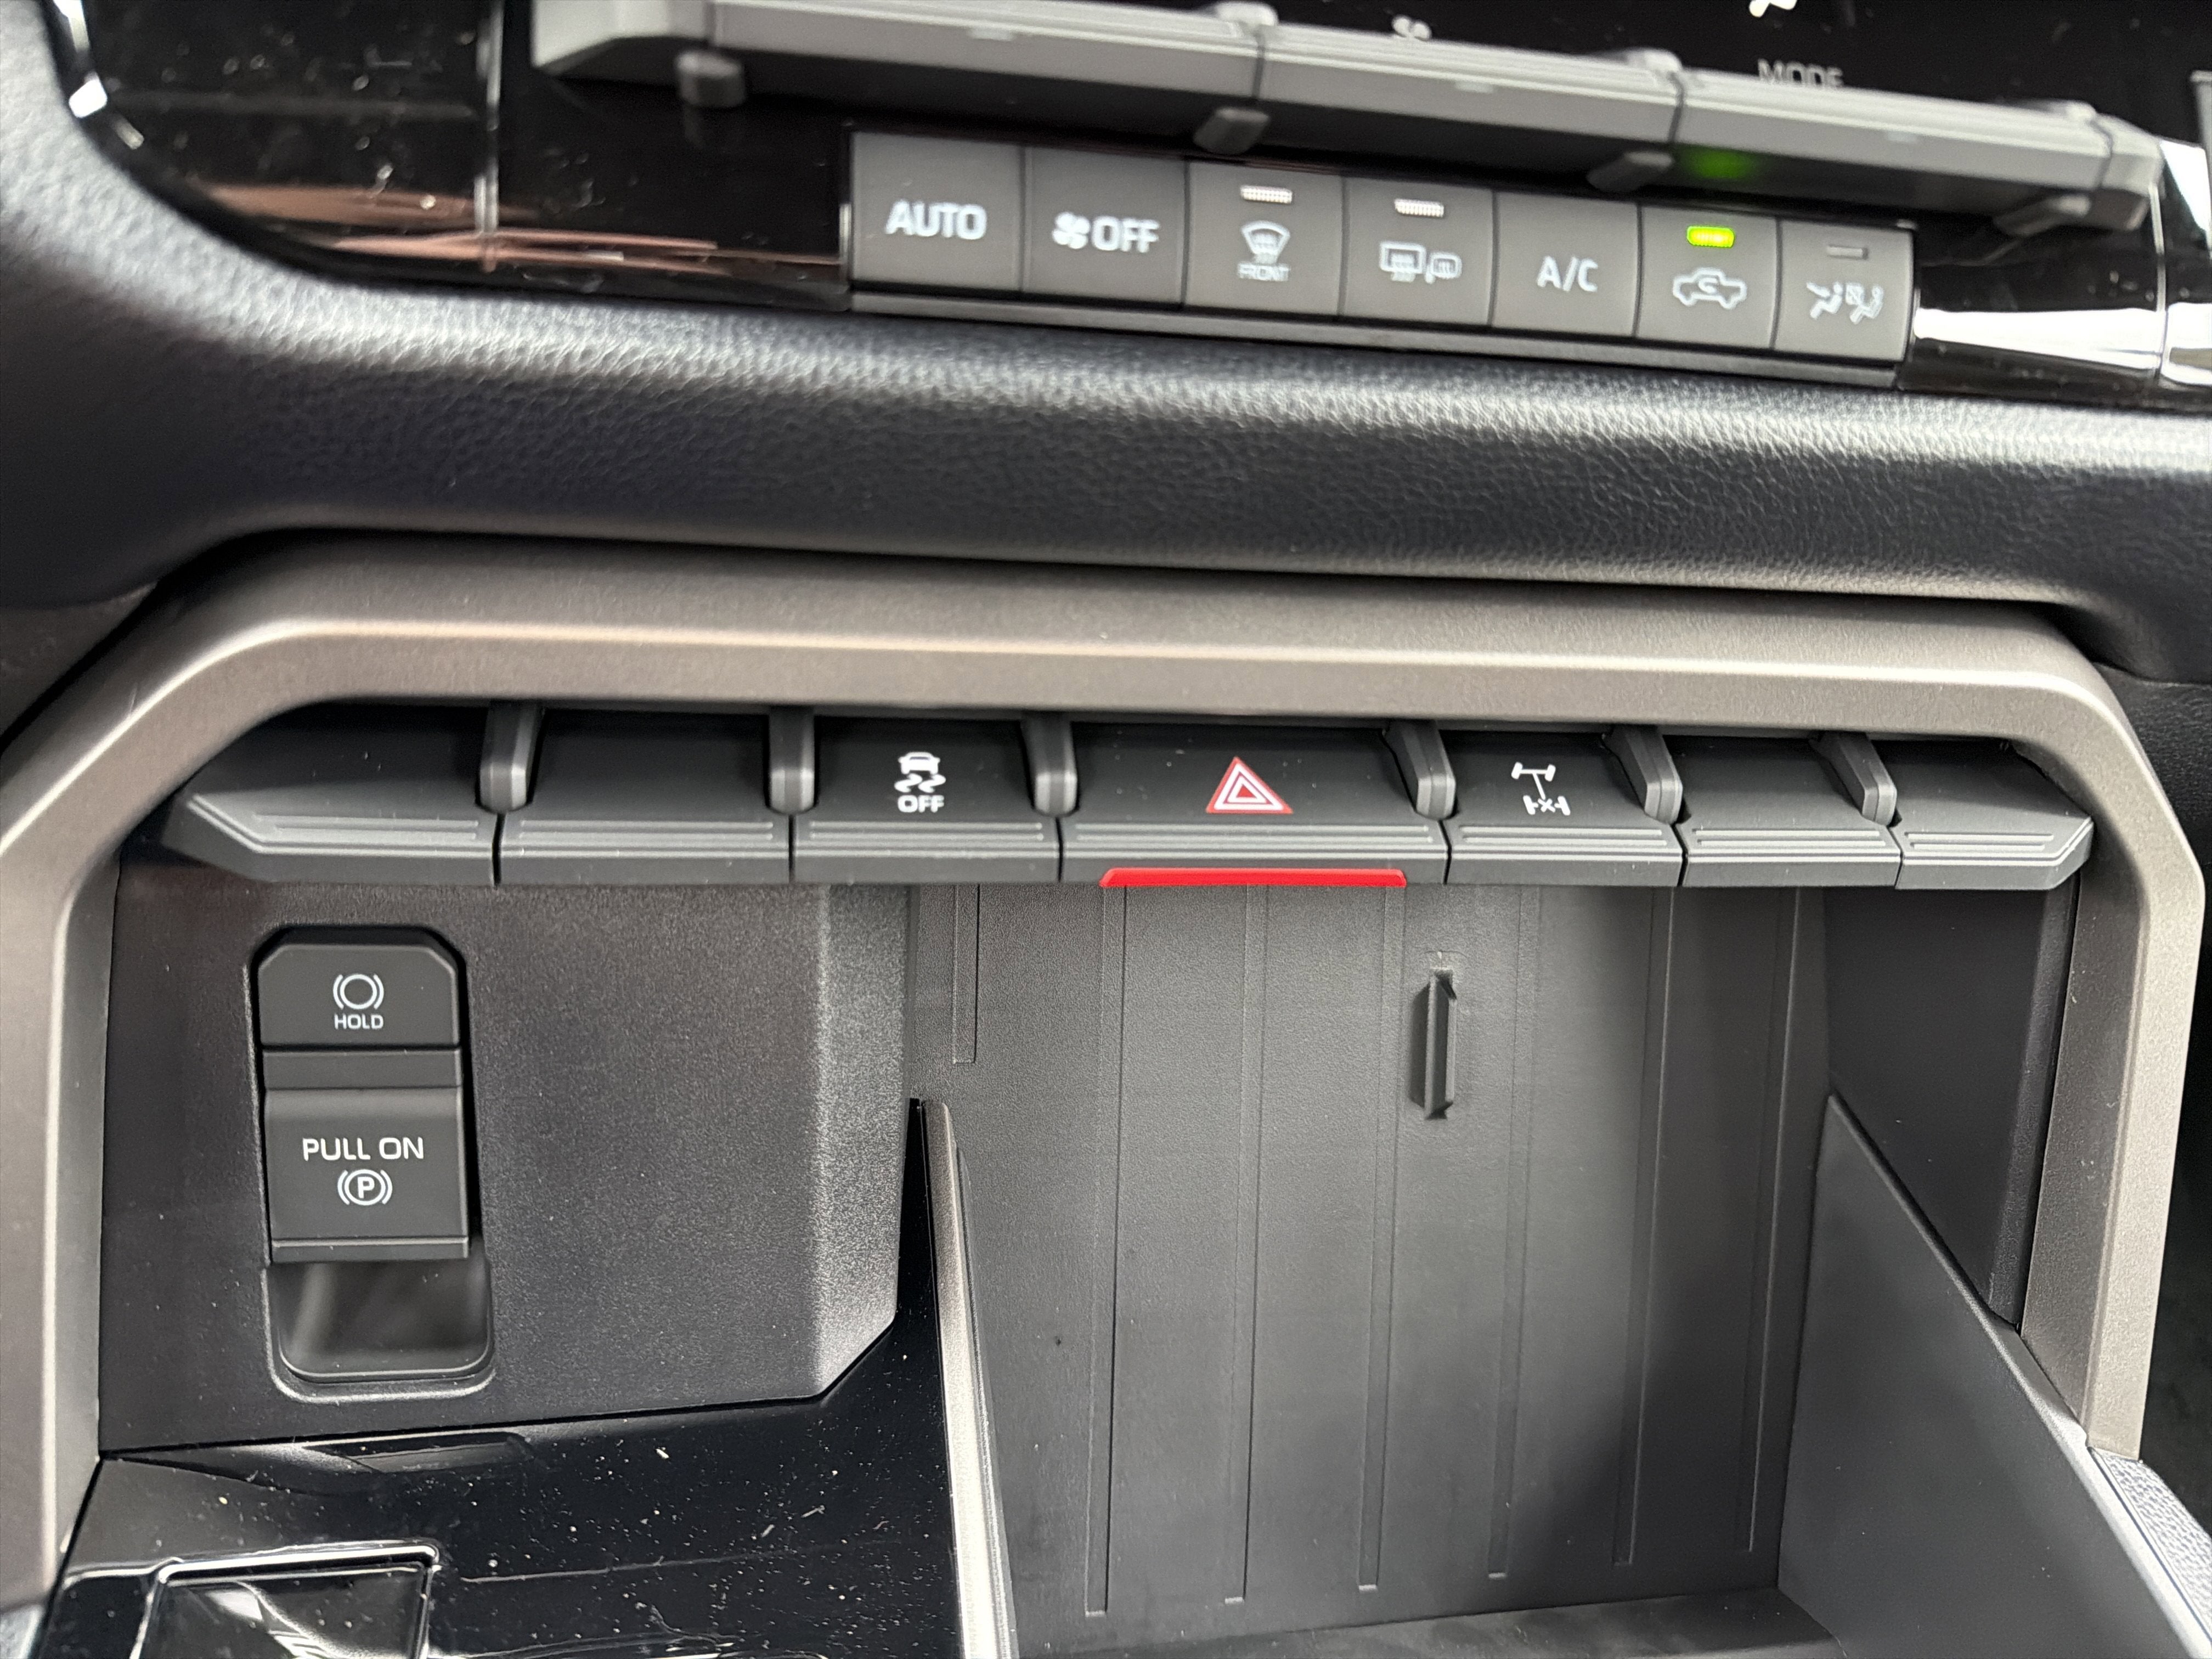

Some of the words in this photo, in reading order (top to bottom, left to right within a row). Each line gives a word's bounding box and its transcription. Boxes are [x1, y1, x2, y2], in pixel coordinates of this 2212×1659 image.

[885, 200, 988, 240] AUTO
[1091, 216, 1161, 254] OFF
[1537, 255, 1598, 293] A/C
[897, 794, 945, 814] OFF
[334, 1013, 384, 1030] HOLD
[302, 1137, 371, 1161] PULL
[379, 1137, 424, 1159] ON
